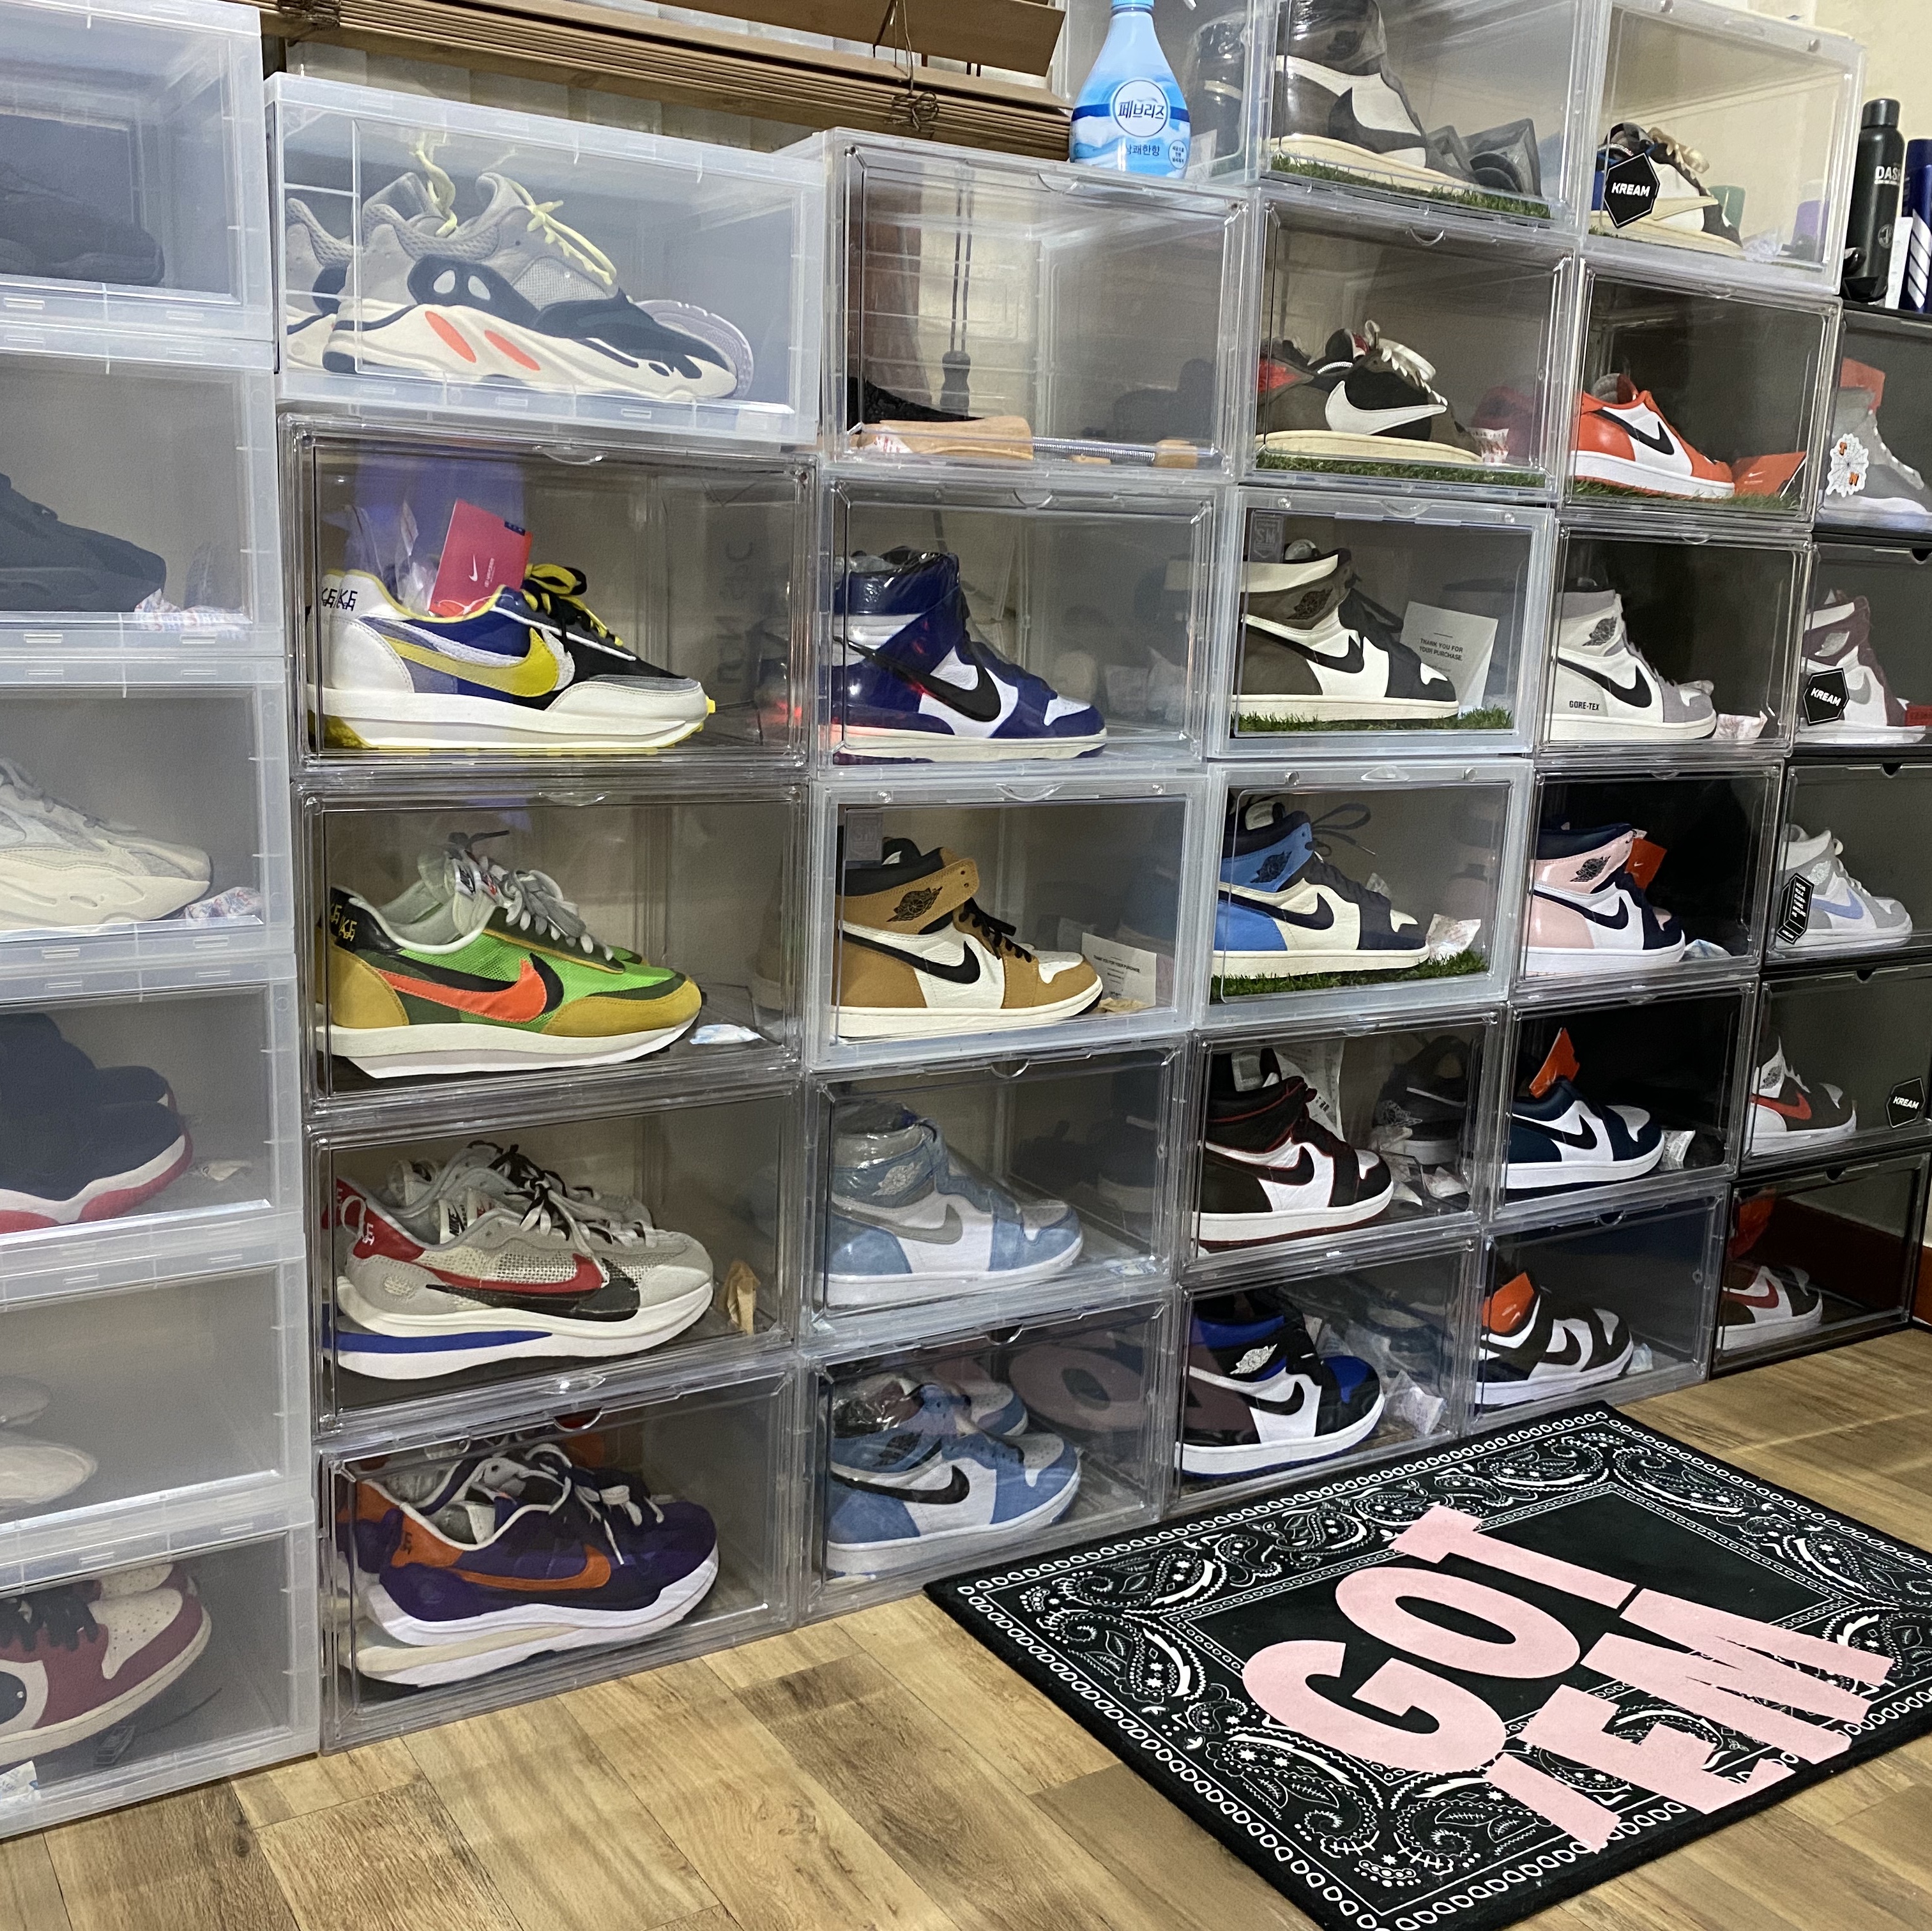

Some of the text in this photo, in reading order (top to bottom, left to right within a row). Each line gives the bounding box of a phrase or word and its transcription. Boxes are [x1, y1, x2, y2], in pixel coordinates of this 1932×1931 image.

[1118, 101, 1164, 119] 페브리즈
[1611, 182, 1651, 197] KREAM
[1420, 638, 1438, 647] THANK
[1419, 646, 1433, 655] YOUR
[1810, 687, 1841, 706] KREAM
[1569, 700, 1599, 711] GORE-TEX
[1892, 1096, 1919, 1110] KREAM
[1242, 1504, 1638, 1773] GOT
